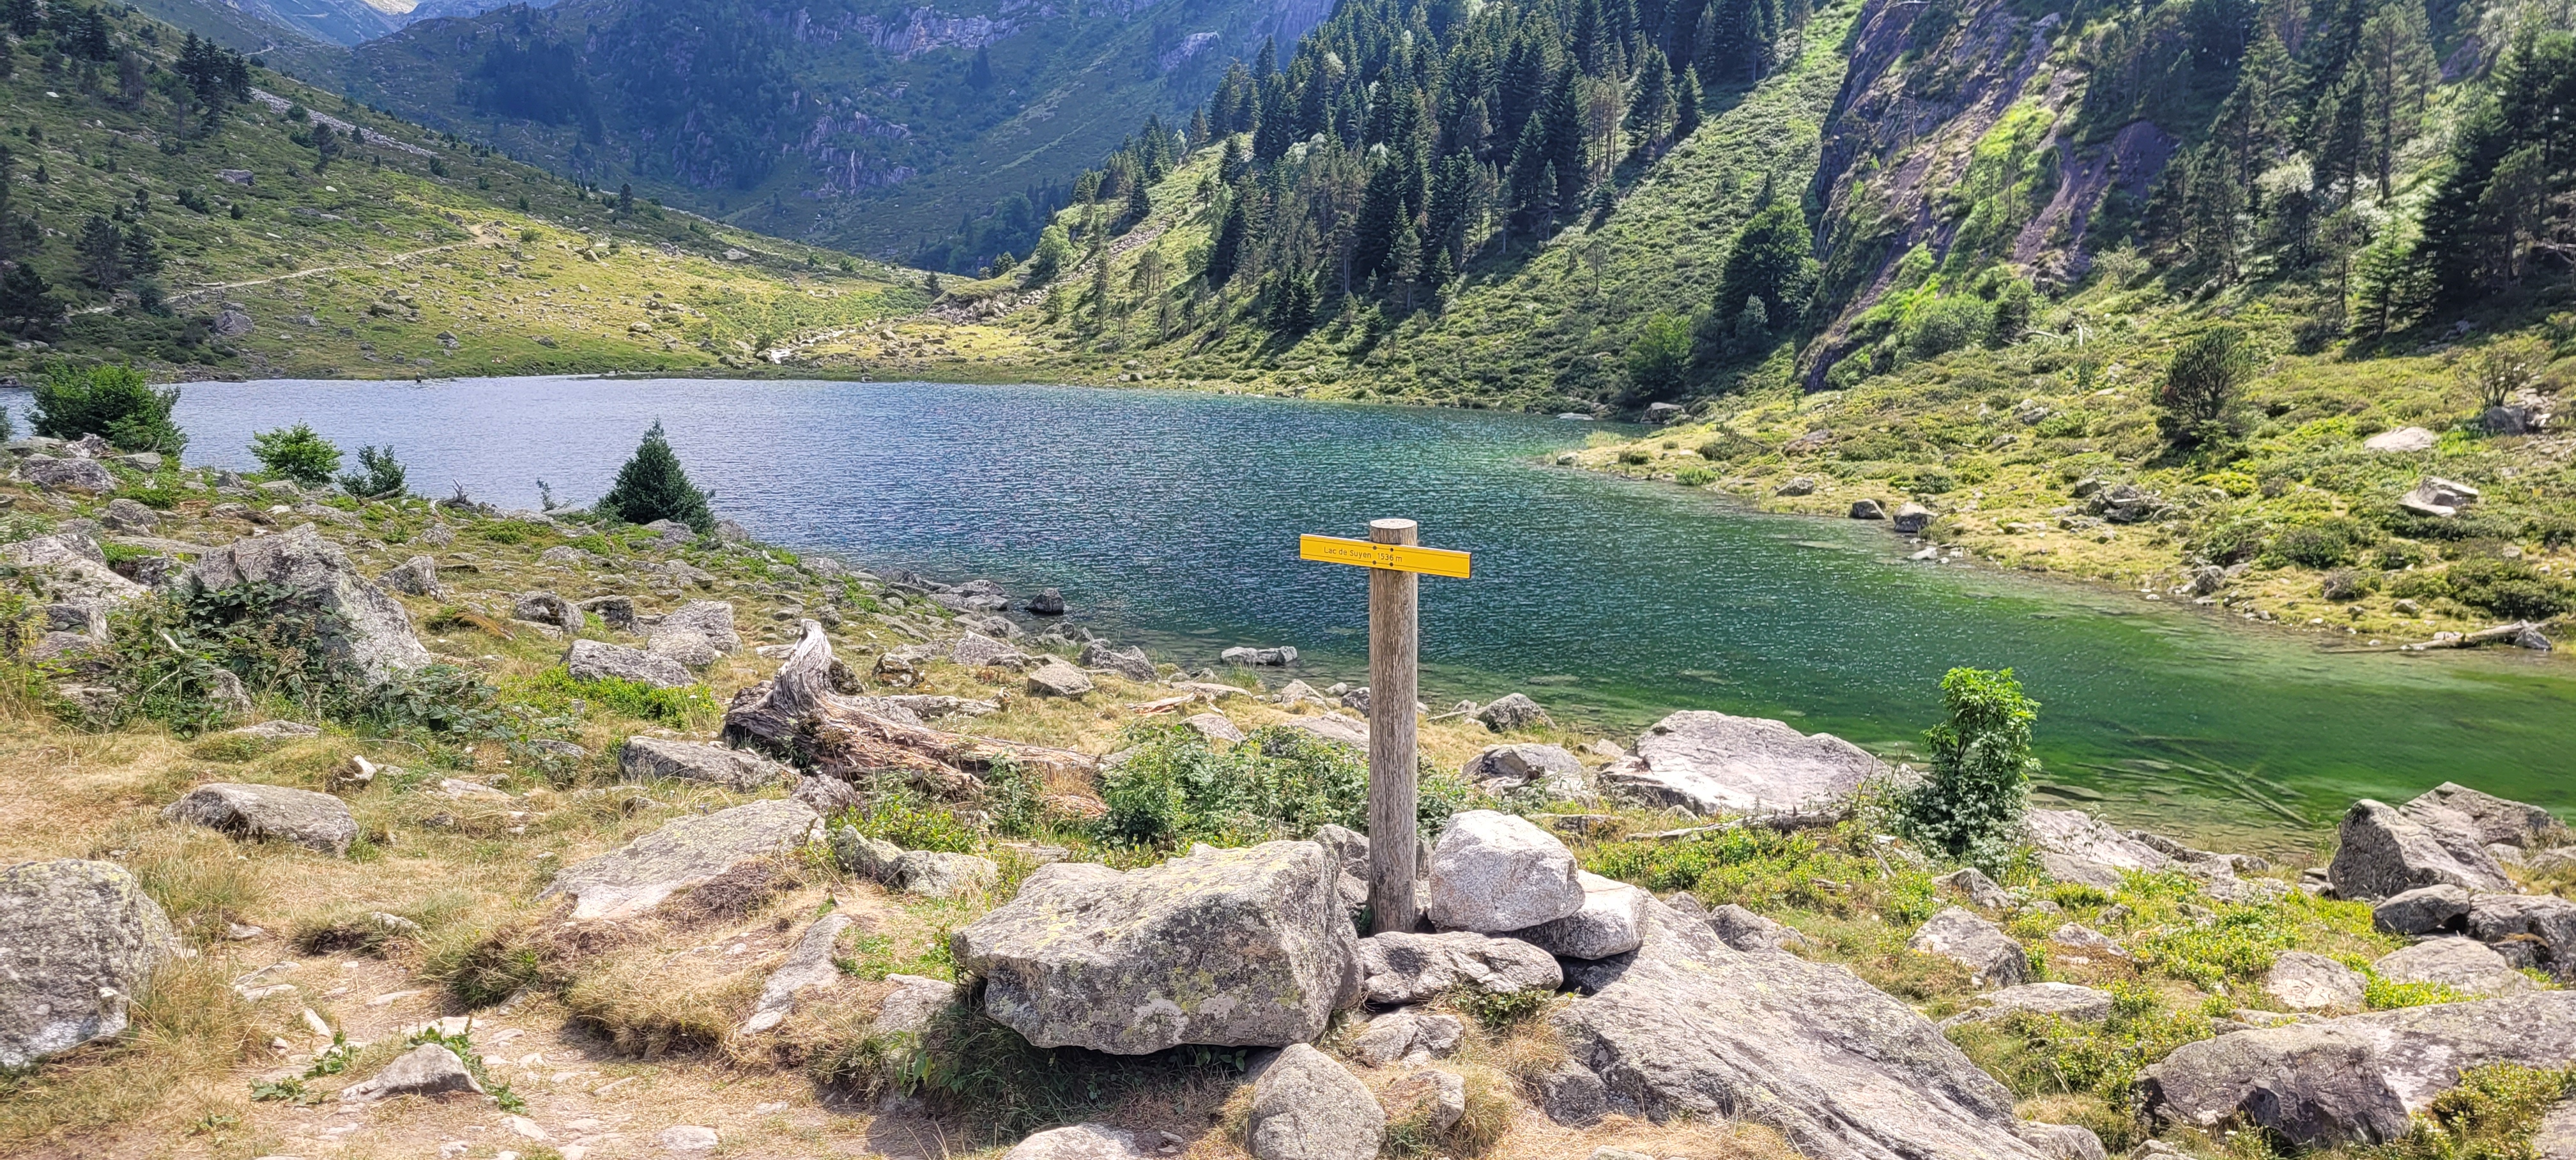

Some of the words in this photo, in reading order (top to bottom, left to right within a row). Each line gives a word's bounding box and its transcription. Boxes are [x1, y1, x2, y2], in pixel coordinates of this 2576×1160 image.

[1324, 546, 1337, 554] Lac
[1349, 549, 1372, 560] Suyen
[1377, 553, 1394, 561] 1536
